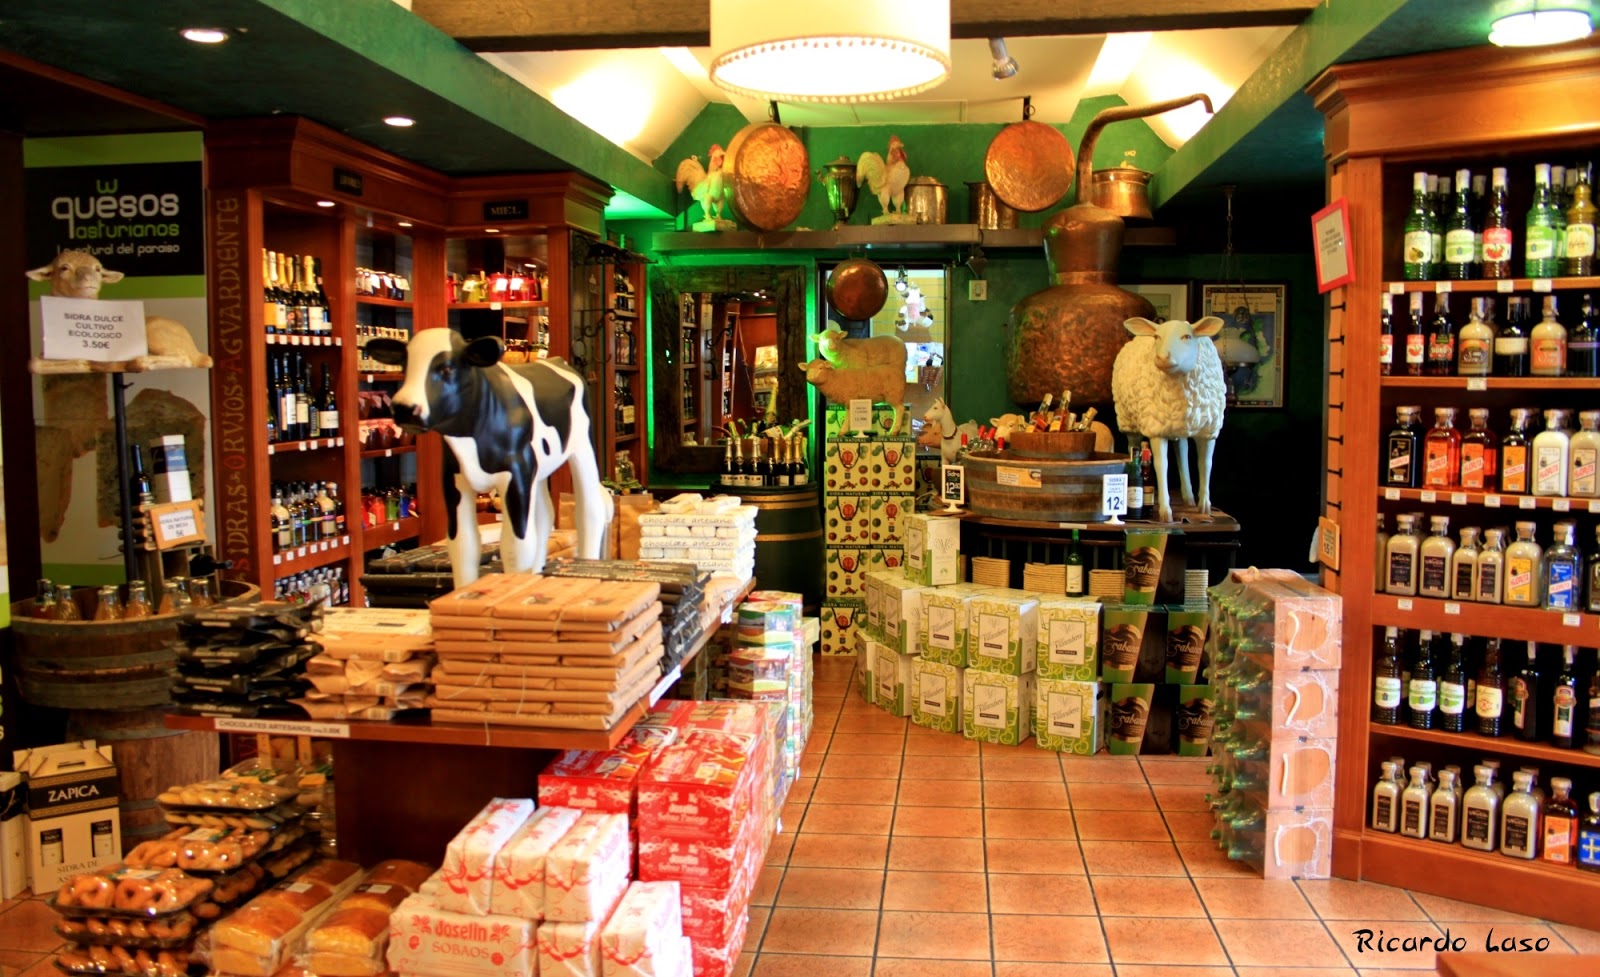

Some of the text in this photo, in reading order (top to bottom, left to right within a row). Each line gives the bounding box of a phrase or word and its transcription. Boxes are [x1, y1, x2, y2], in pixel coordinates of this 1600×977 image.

[51, 193, 180, 239] quesos
[75, 220, 180, 239] asturianos
[116, 242, 134, 254] del
[64, 313, 92, 321] SIDRA
[75, 322, 115, 330] CULTIVO
[68, 330, 123, 339] ECOLOGICO
[82, 340, 110, 349] 3.50€
[219, 720, 267, 729] CHOCOLATES
[268, 723, 312, 733] ARTESANOS
[48, 785, 99, 802] ZAPICA
[668, 804, 699, 814] Joselin
[668, 855, 699, 865] Joselin
[57, 861, 84, 873] SIDRA
[435, 920, 488, 942] Joselin
[432, 941, 490, 959] SOBAOS
